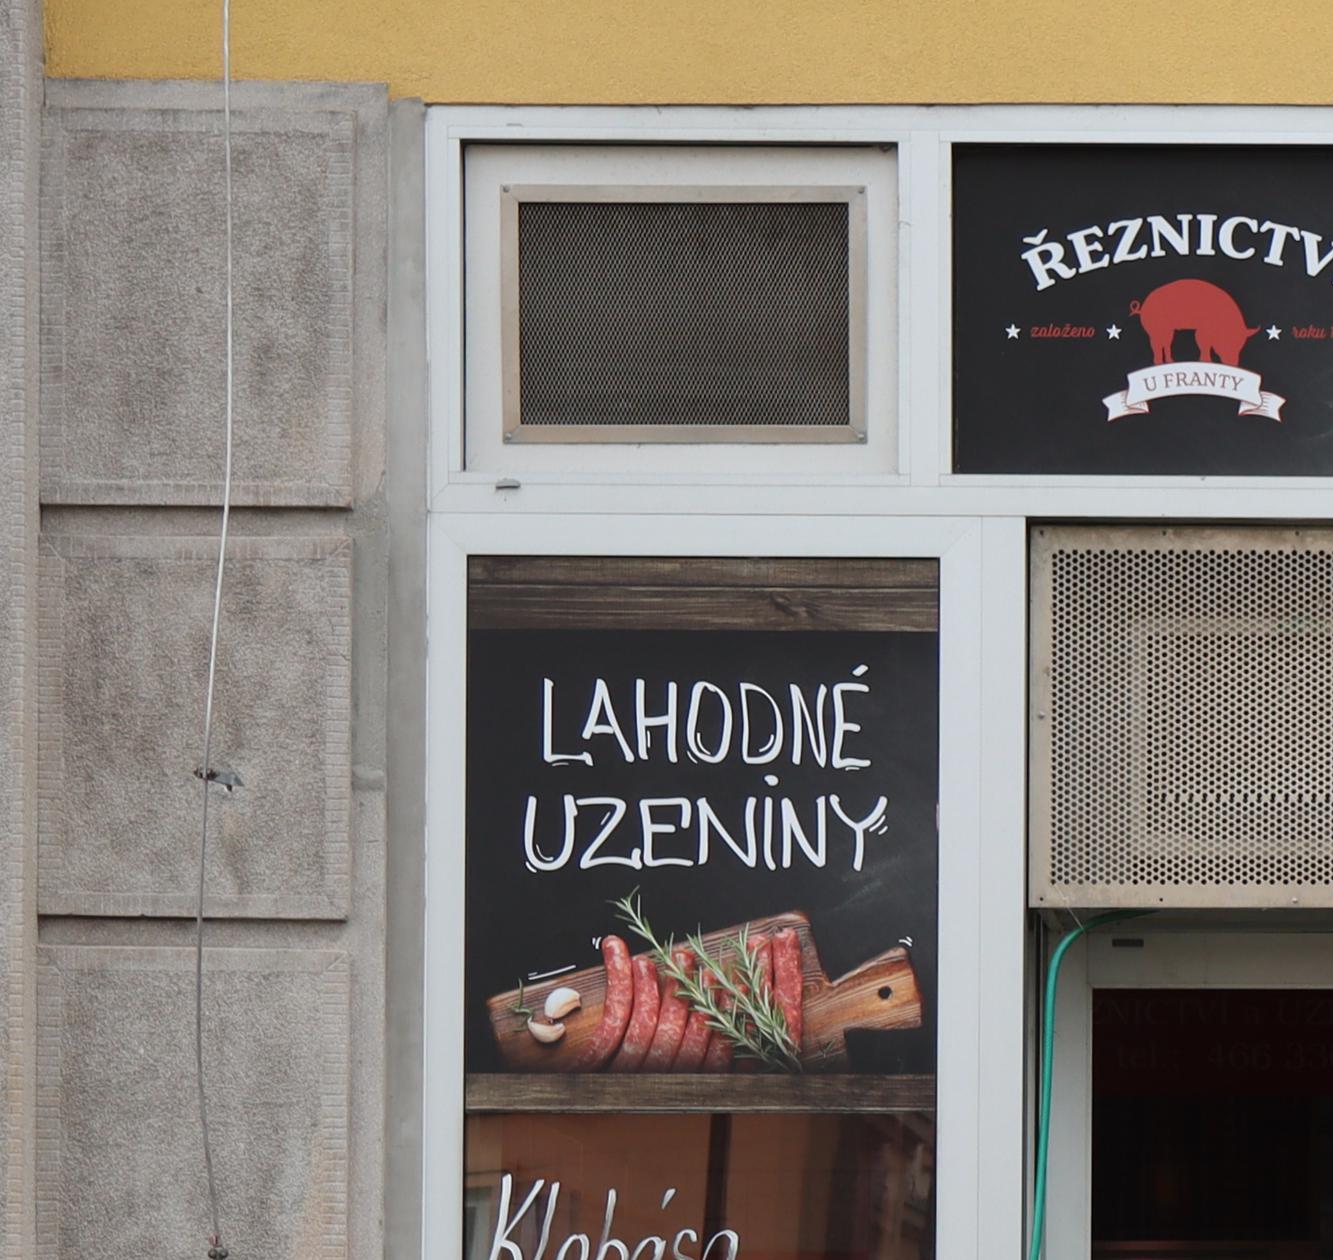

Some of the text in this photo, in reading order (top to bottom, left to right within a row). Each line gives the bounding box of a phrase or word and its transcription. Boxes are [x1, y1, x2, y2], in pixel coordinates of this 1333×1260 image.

[1030, 325, 1095, 338] založeno
[1291, 325, 1327, 338] roku
[1143, 372, 1244, 391] U FRANTY
[543, 664, 872, 771] LAHODNÉ
[524, 775, 888, 873] UZENINY
